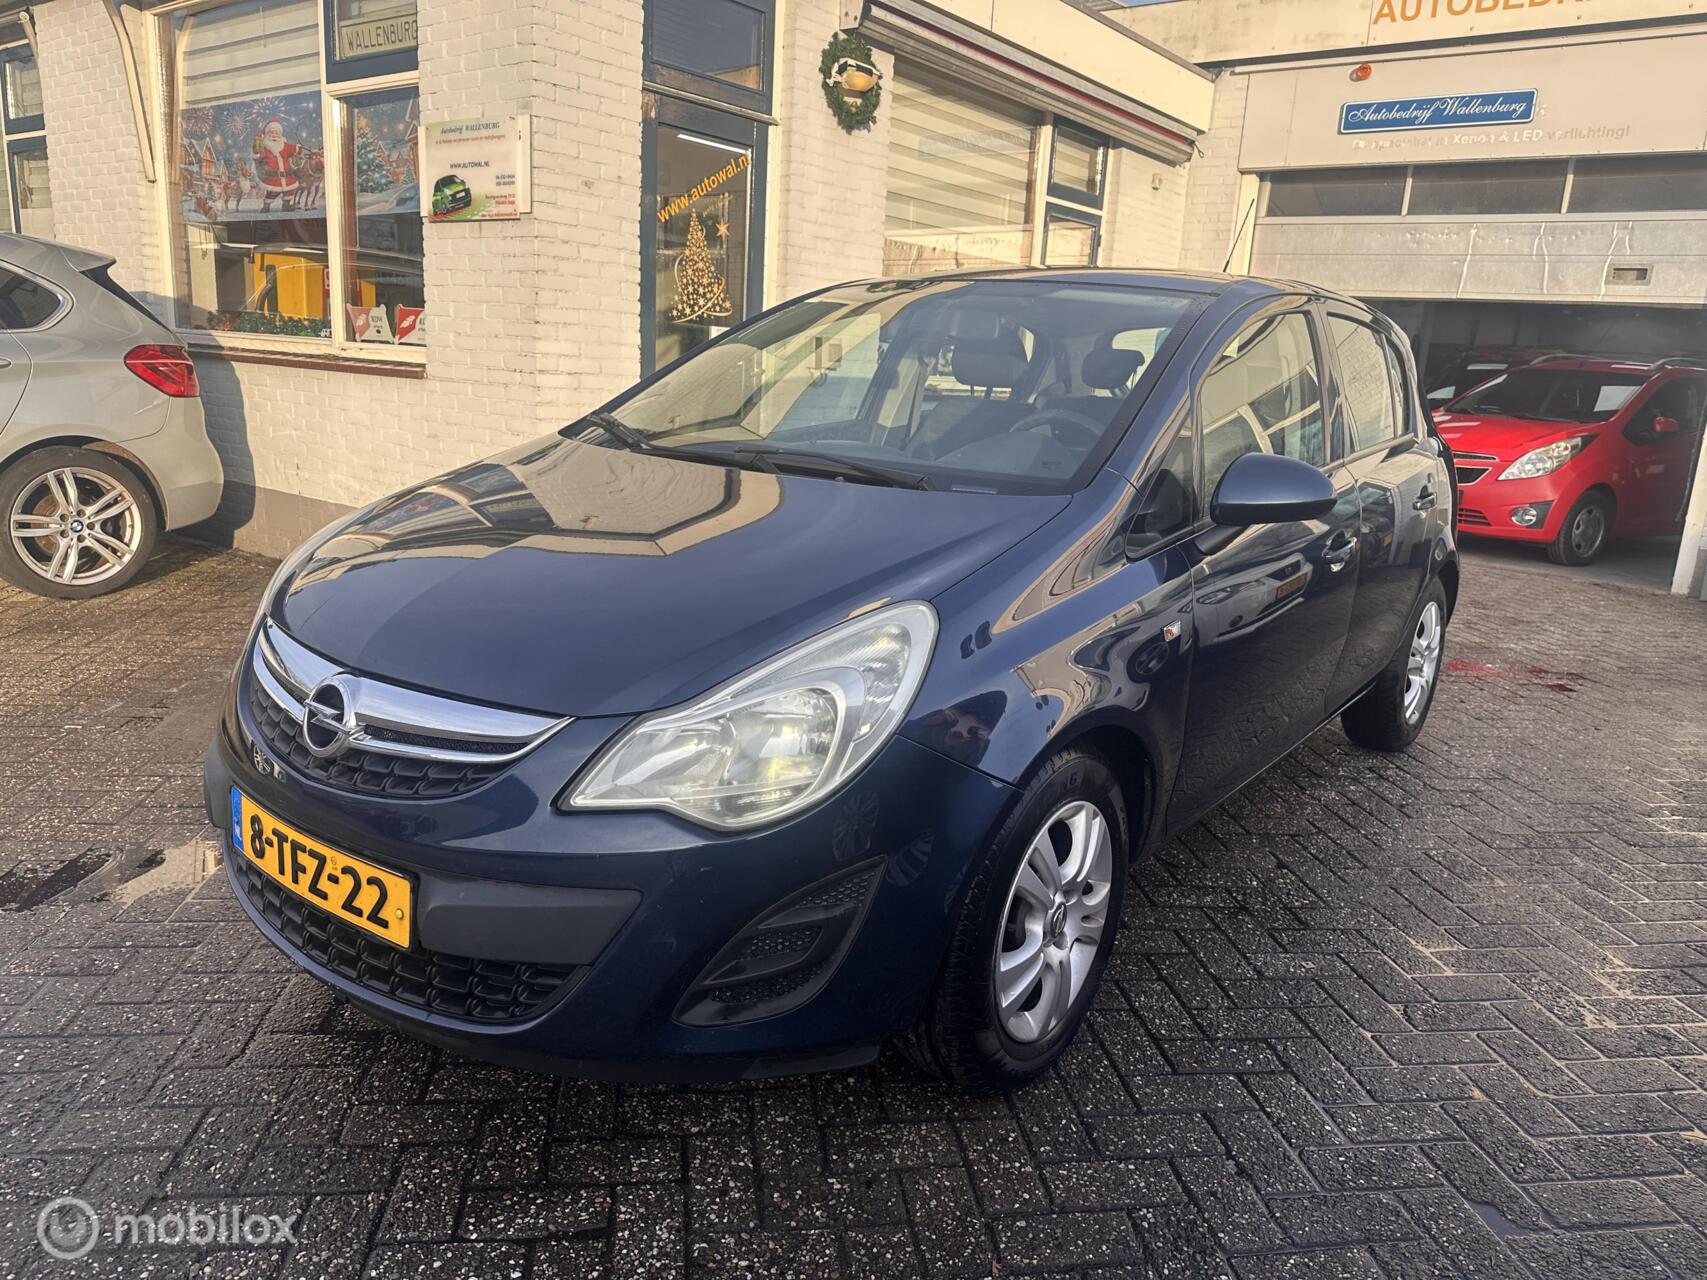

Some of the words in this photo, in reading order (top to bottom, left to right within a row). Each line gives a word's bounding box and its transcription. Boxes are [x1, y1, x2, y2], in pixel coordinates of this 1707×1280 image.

[1372, 0, 1583, 24] AUTOB
[345, 20, 417, 51] WALLENBURG
[1348, 101, 1440, 124] Autobedrijf
[1439, 97, 1527, 118] Wallenburg
[1513, 129, 1543, 142] LED
[250, 814, 389, 929] 8-TFZ-22
